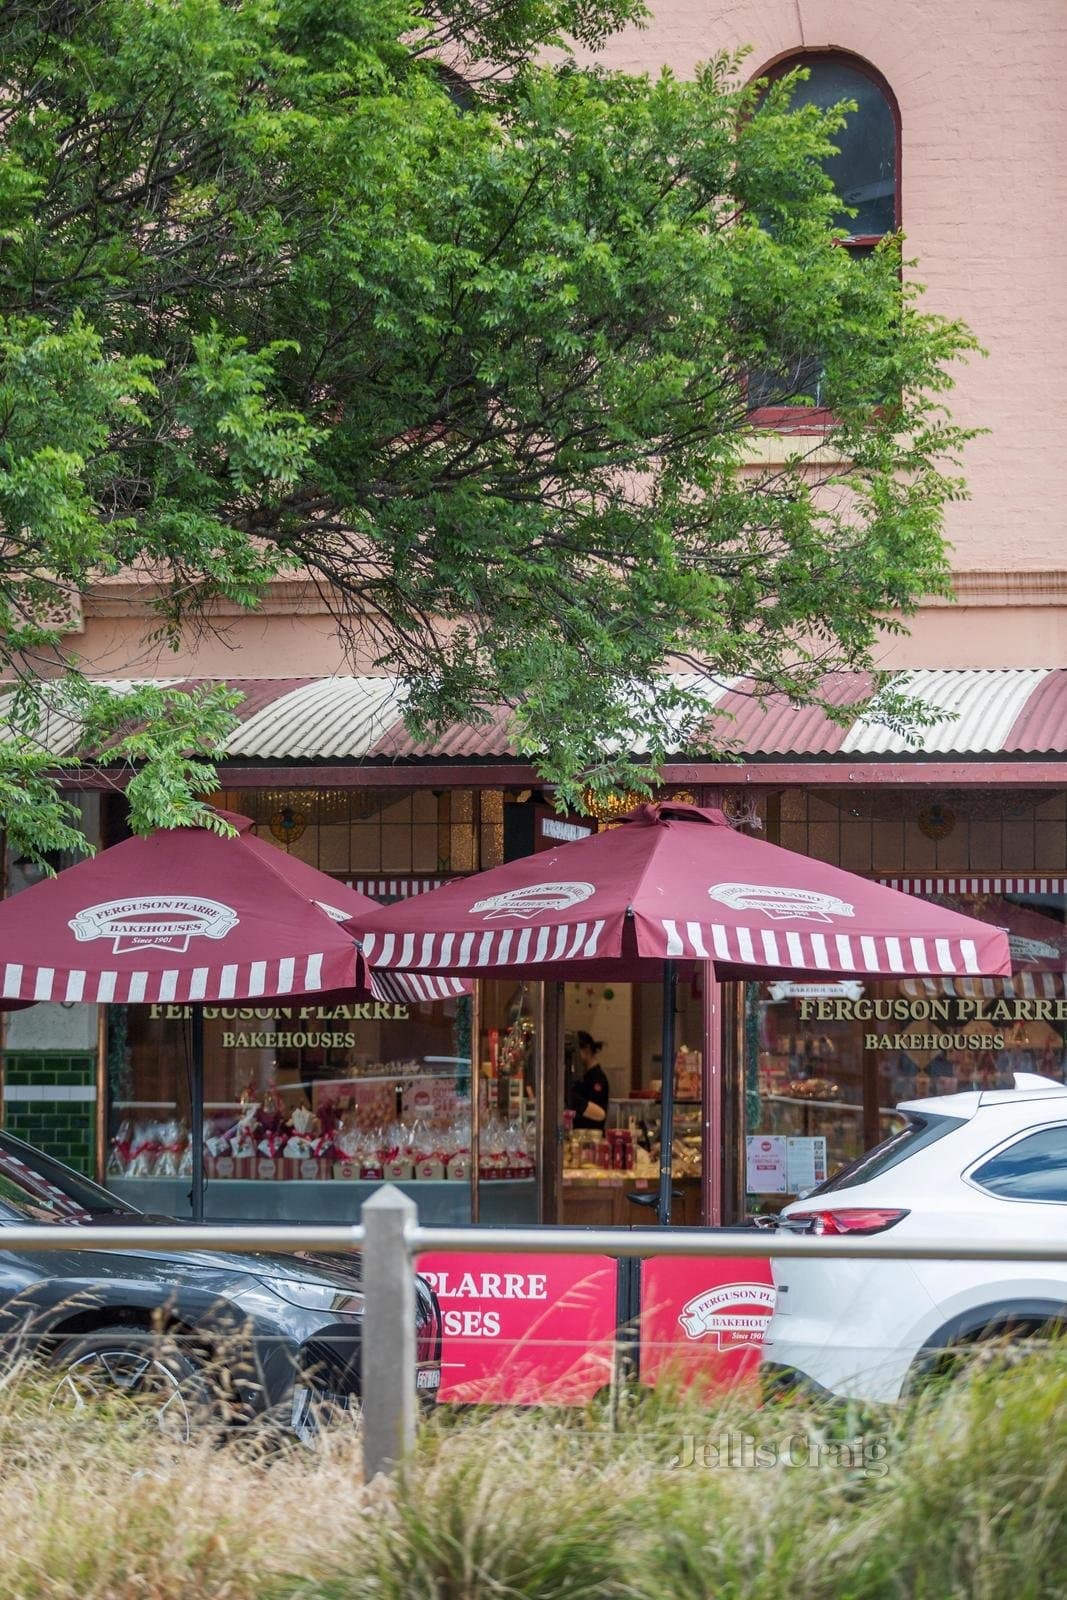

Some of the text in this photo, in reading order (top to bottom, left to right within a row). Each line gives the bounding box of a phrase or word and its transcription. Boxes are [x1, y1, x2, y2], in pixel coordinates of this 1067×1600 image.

[96, 901, 220, 919] FERGUSON PLARRE
[109, 923, 202, 933] BAKEHOUSES
[131, 936, 172, 944] Since 1901
[799, 999, 1067, 1021] FERGUSON PLARRE
[222, 1032, 356, 1048] BAKEHOUSES
[864, 1033, 1005, 1050] BAKEHOUSES
[698, 1290, 757, 1312] FERGUSON
[731, 1331, 749, 1340] Since
